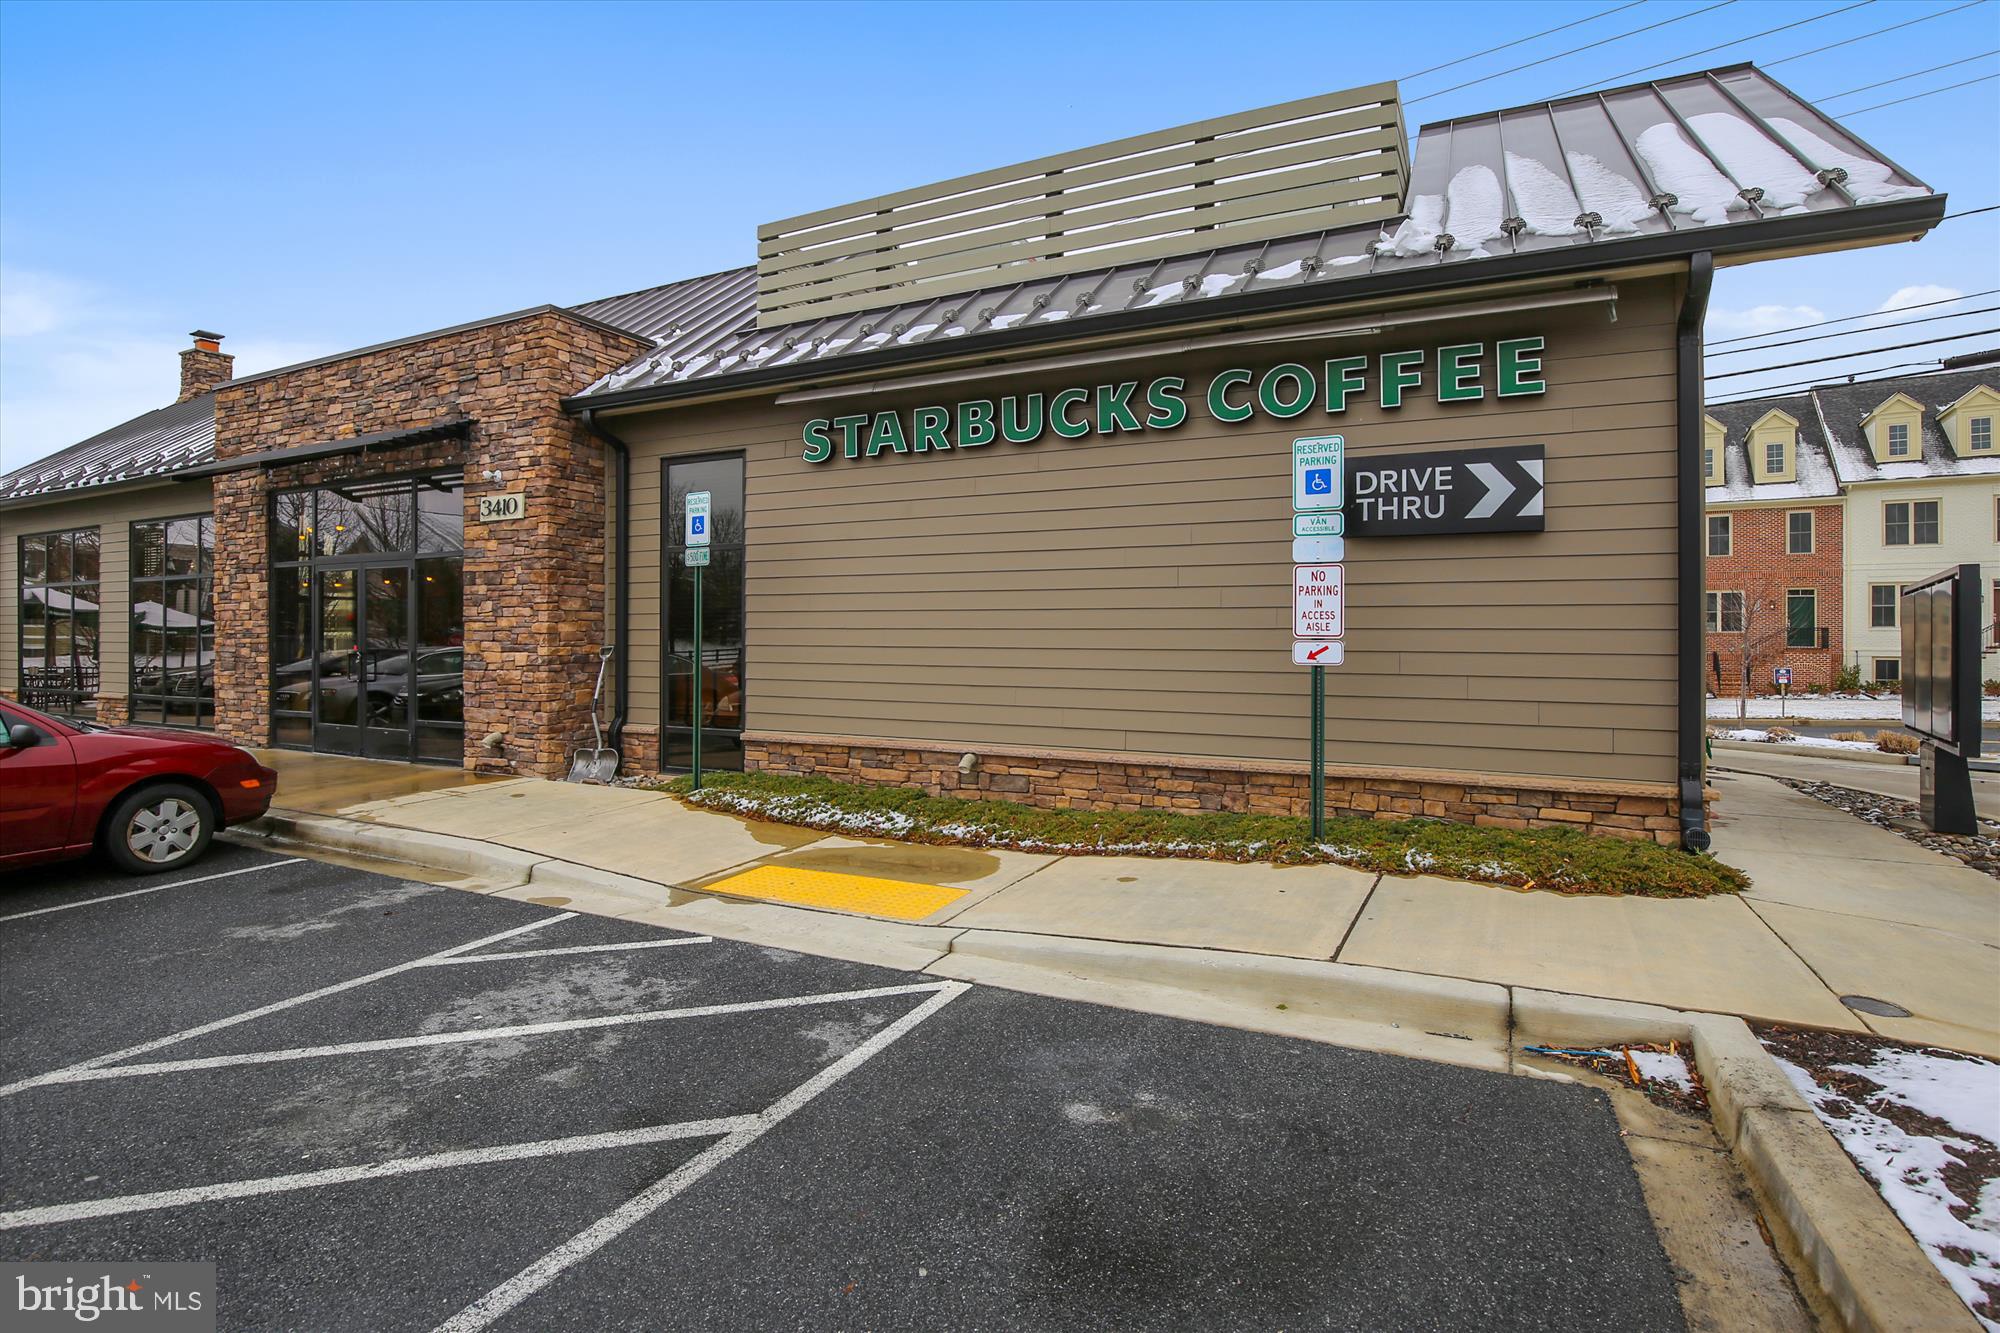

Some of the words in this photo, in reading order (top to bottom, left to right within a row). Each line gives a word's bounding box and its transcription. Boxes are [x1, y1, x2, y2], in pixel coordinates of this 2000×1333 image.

[802, 376, 1187, 463] STARBUCKS
[1207, 336, 1546, 423] COFFEE
[1297, 442, 1340, 455] RESERVED
[1299, 455, 1337, 467] PARKING
[1355, 466, 1453, 495] DRIVE
[481, 497, 518, 517] 3410
[1355, 494, 1445, 521] THRU
[1310, 517, 1328, 526] VAN
[1301, 525, 1335, 533] ACCESSIBLE
[1311, 570, 1326, 582] NO
[1298, 584, 1339, 596] PARKING
[1313, 599, 1323, 609] IN
[1301, 610, 1336, 620] ACCESS
[1305, 622, 1331, 632] AISLE
